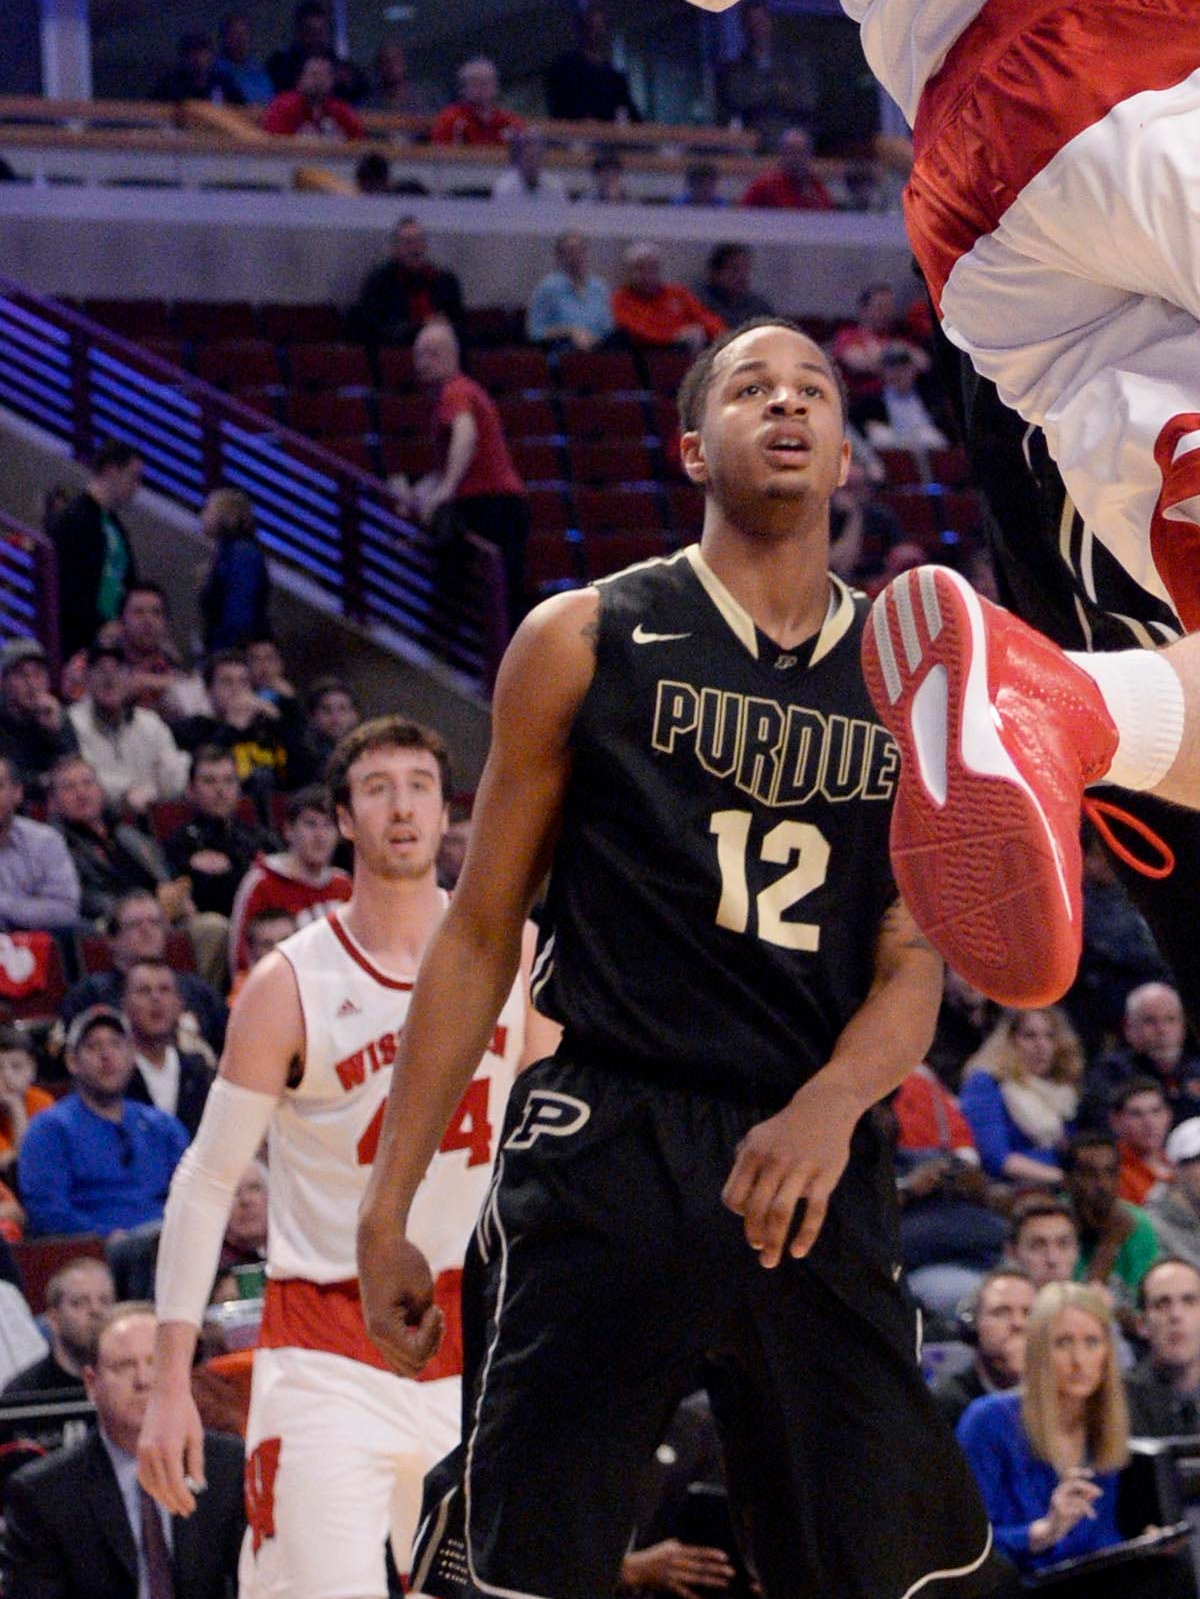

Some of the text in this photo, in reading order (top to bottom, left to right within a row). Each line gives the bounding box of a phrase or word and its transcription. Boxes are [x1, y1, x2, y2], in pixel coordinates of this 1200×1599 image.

[652, 680, 901, 807] PURDUE
[709, 809, 831, 952] 12
[503, 1089, 591, 1150] P
